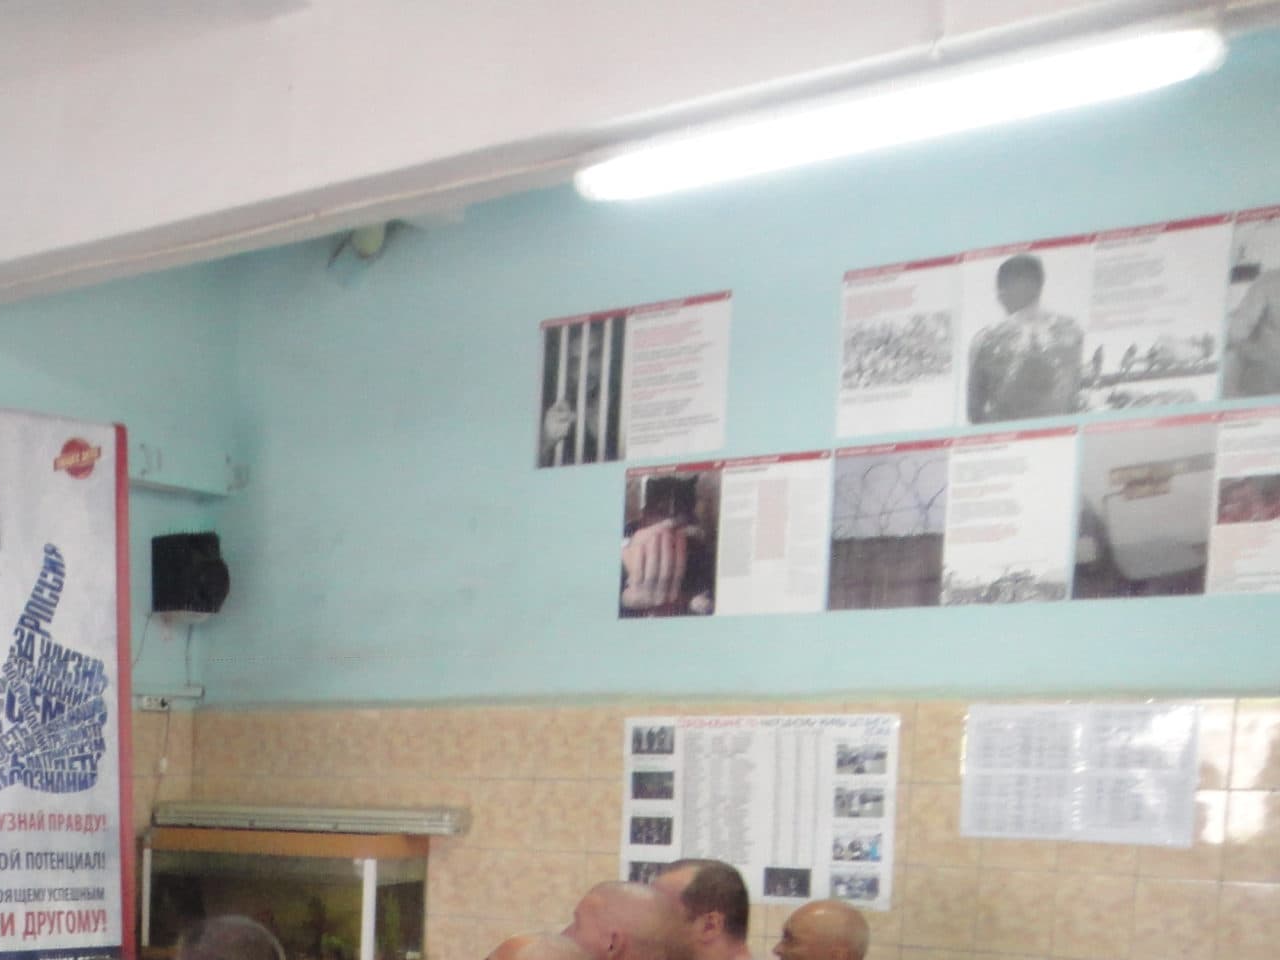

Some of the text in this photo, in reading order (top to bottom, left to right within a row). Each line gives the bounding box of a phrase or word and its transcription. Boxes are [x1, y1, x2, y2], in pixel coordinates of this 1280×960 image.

[48, 812, 107, 834] ПРАВДУ!
[25, 850, 106, 873] ПОТЕНЦИАЛ!
[23, 909, 107, 941] ДРУГОМУ!
